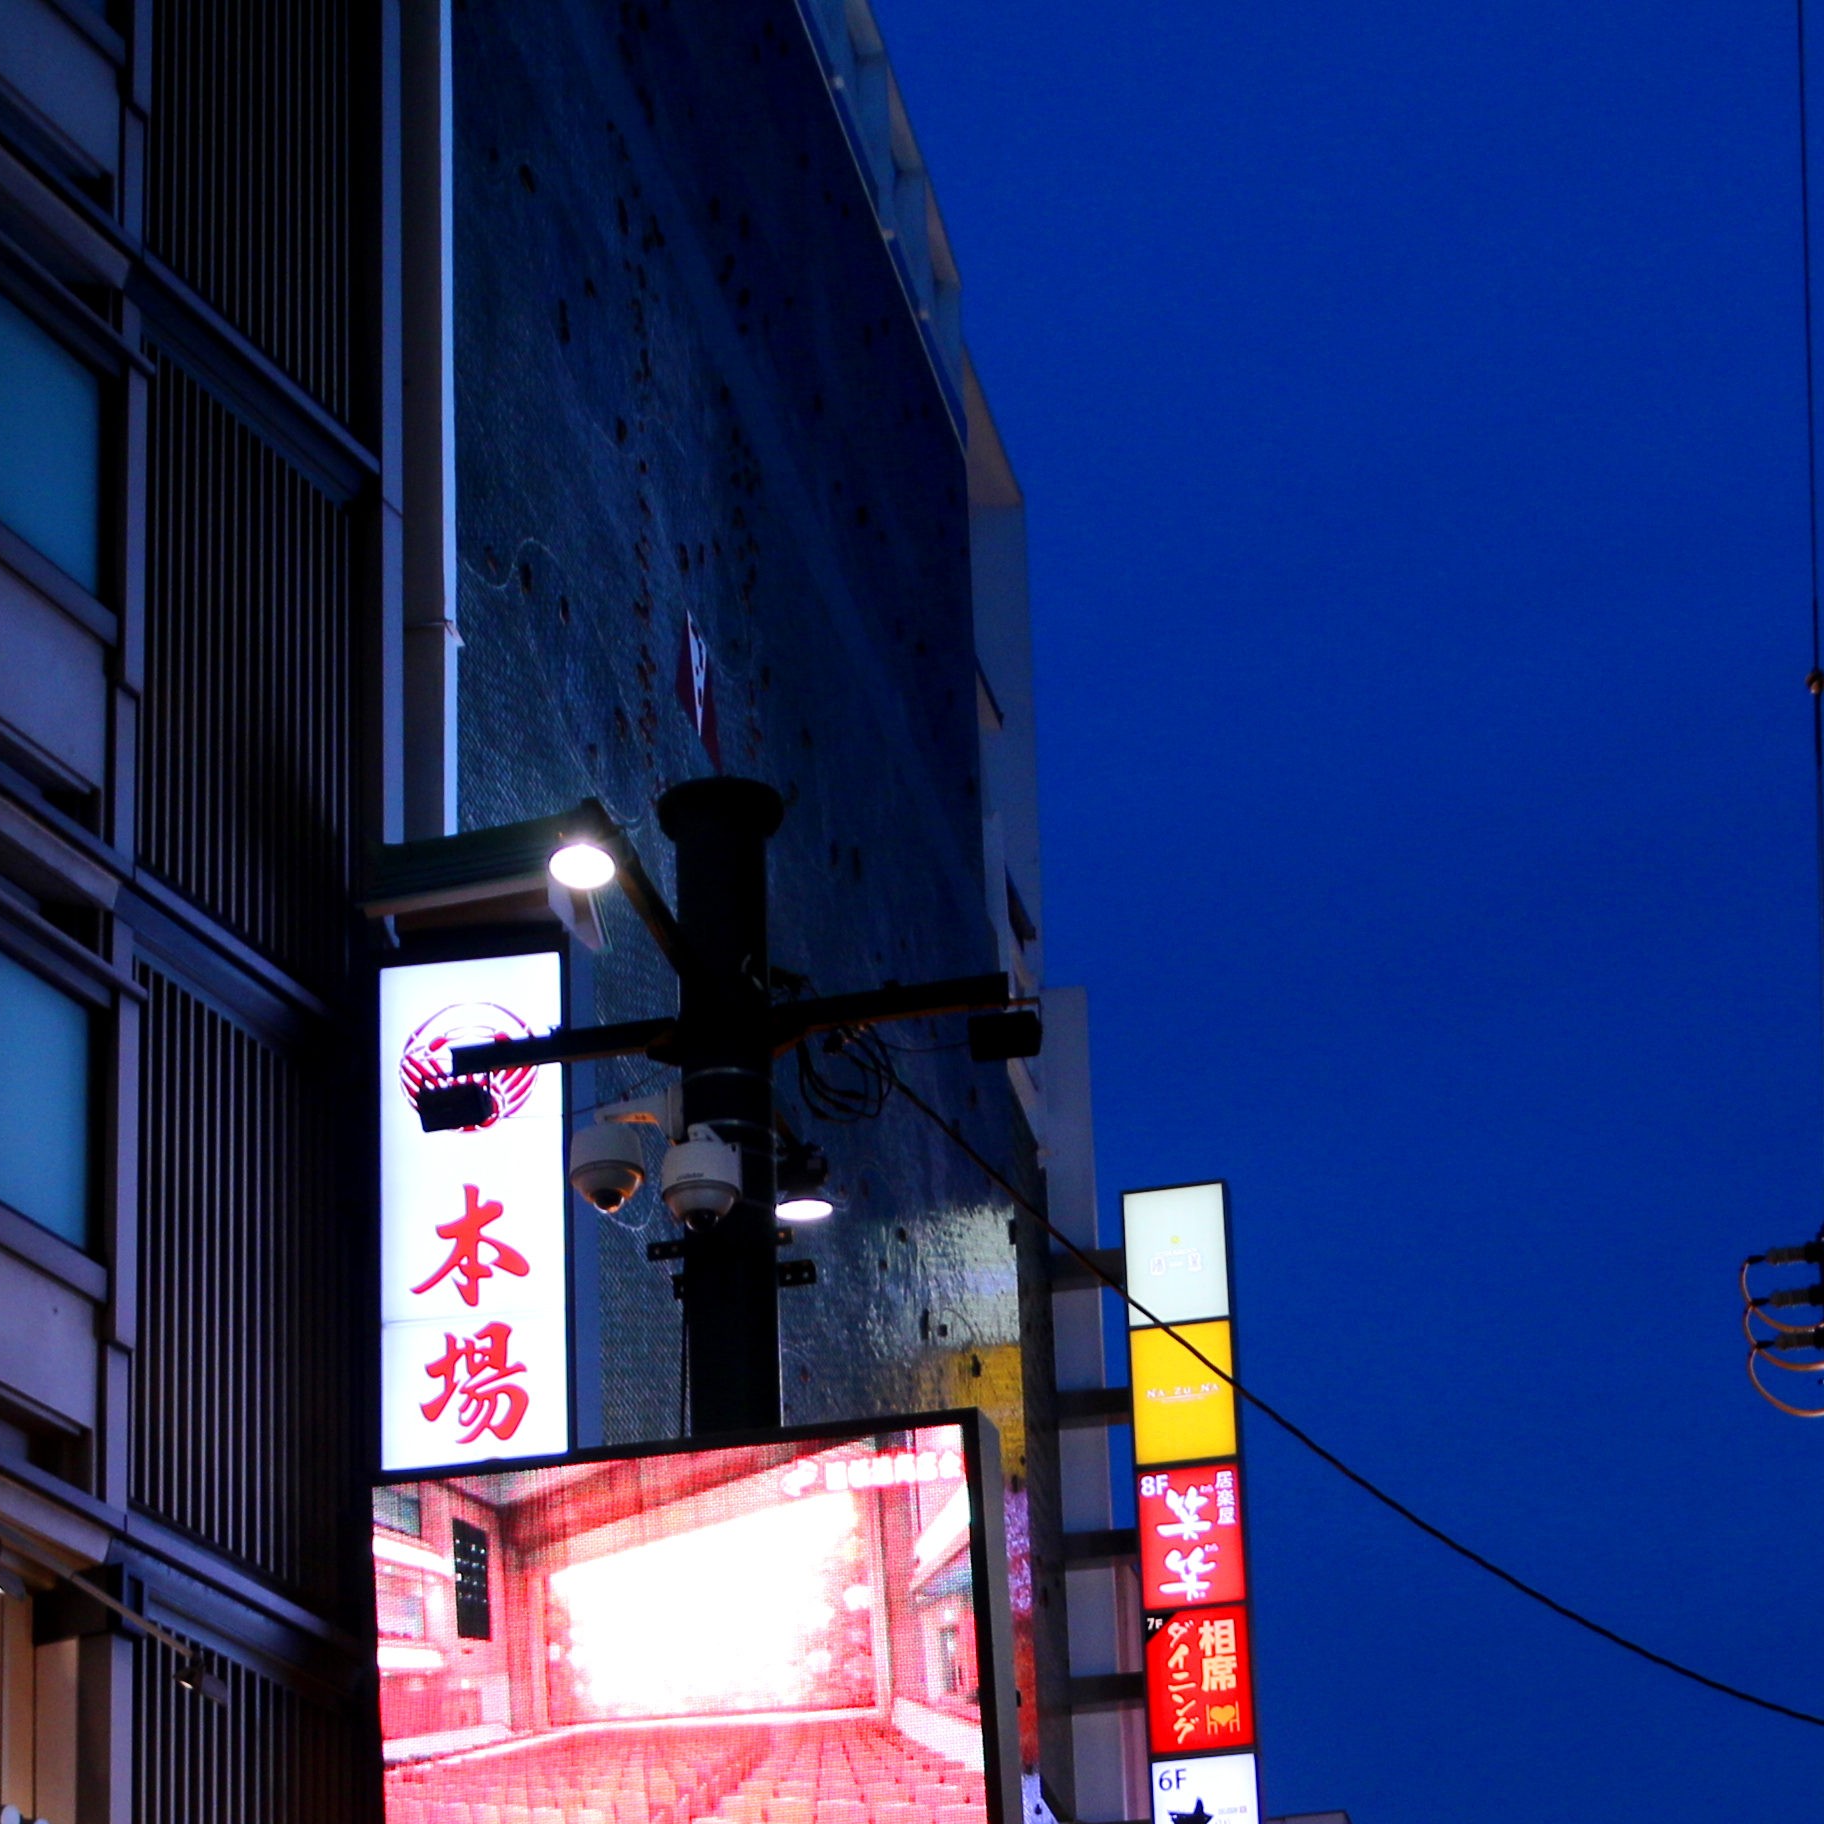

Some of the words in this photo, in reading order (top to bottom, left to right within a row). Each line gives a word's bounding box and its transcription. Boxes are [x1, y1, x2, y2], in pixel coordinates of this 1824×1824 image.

[410, 1183, 530, 1445] 本場
[1139, 1473, 1170, 1498] 8F
[1146, 1616, 1164, 1631] 7F
[1198, 1618, 1238, 1693] 相席
[1167, 1619, 1200, 1745] ダイニング
[1158, 1768, 1188, 1792] 6F
